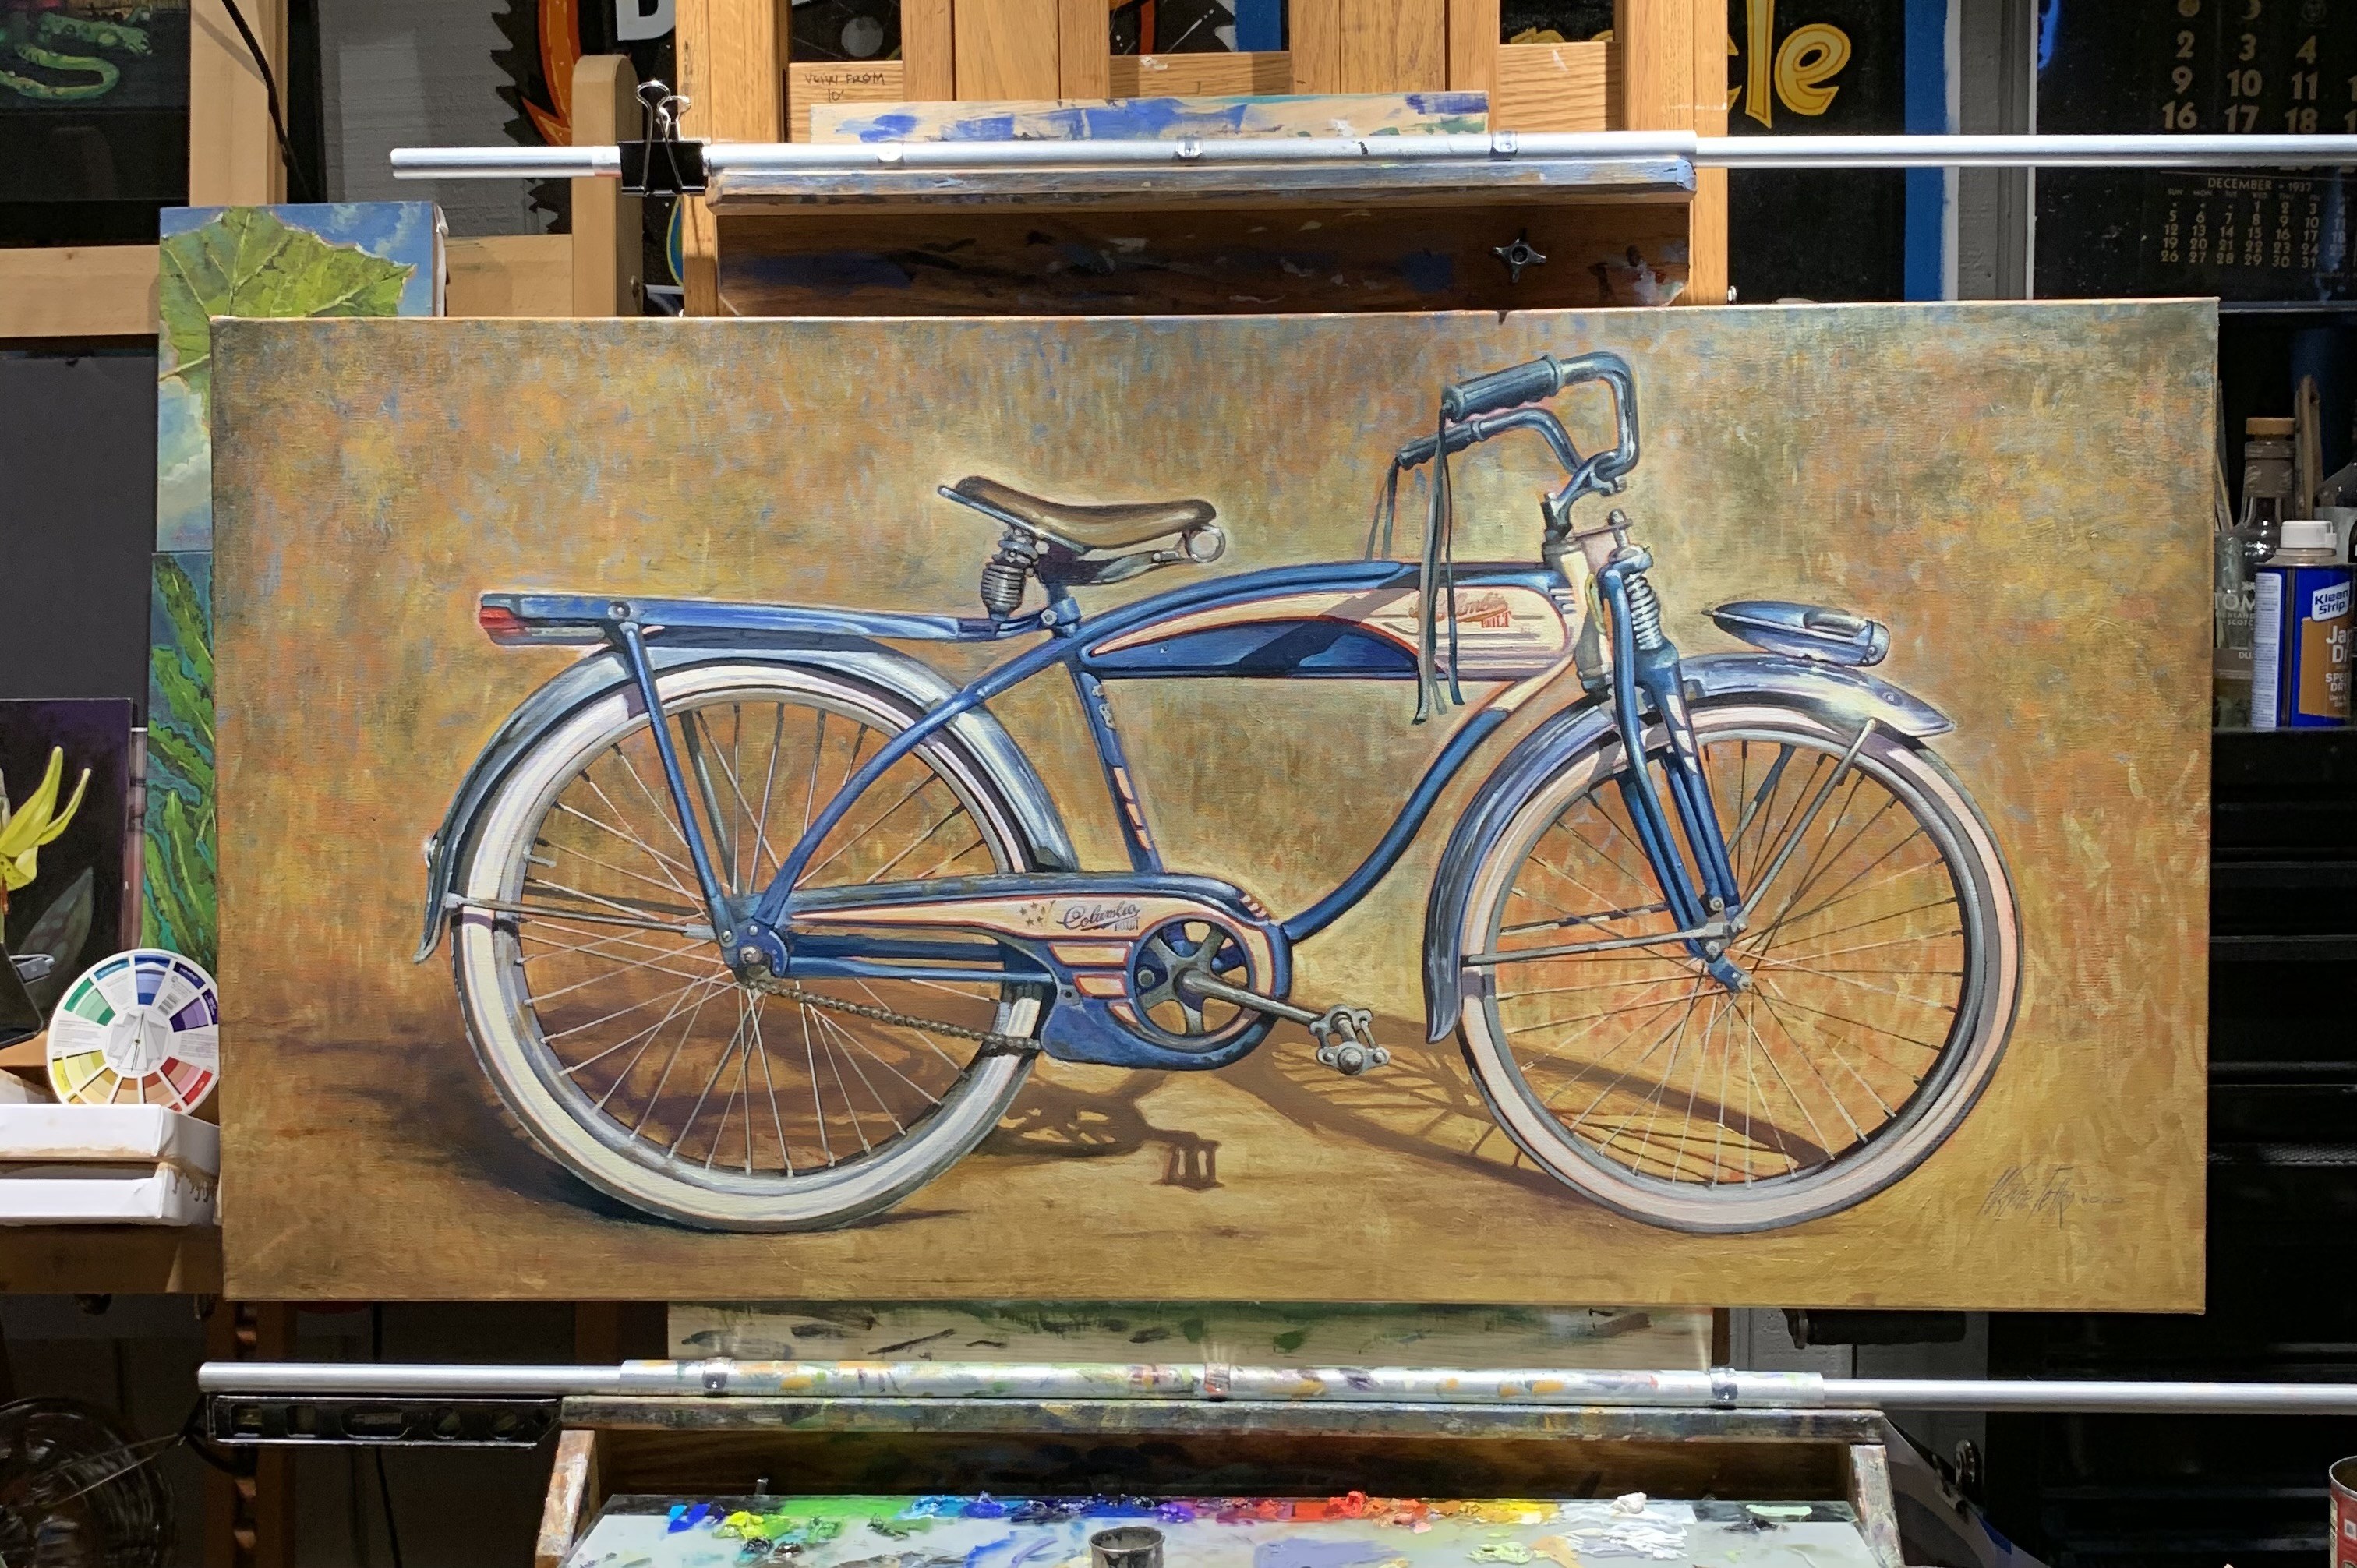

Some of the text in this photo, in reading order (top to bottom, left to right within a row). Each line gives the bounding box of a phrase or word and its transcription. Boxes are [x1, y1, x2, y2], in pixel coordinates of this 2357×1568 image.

[2175, 30, 2317, 64] 2 3 4
[846, 72, 885, 86] FROM
[2172, 65, 2193, 94] 9
[2227, 69, 2263, 97] 10
[2292, 71, 2318, 100] 11
[2162, 101, 2197, 129] 16
[2224, 104, 2260, 132] 17
[2285, 107, 2319, 133] 18
[2208, 178, 2272, 189] DECEMBER
[2281, 202, 2289, 214] 2
[2309, 203, 2317, 215] 3
[2169, 210, 2177, 221] 5
[2196, 212, 2205, 223] 6
[2225, 213, 2233, 224] 7
[2253, 214, 2260, 226] 8
[2280, 215, 2289, 228] 9
[2305, 216, 2320, 229] 10
[2165, 224, 2179, 235] 12
[2192, 224, 2207, 236] 13
[2220, 226, 2235, 238] 14
[2248, 227, 2262, 239] 15
[2276, 228, 2290, 240] 16
[2304, 230, 2318, 242] 17
[2163, 237, 2178, 249] 19
[2189, 238, 2207, 249] 20
[2219, 239, 2234, 251] 21
[2246, 240, 2263, 253] 22
[2274, 242, 2291, 254] 23
[2302, 243, 2319, 256] 24
[2161, 250, 2316, 269] 26 27 28 29 30 31
[2315, 589, 2348, 606] Klean
[2319, 601, 2345, 615] Strip
